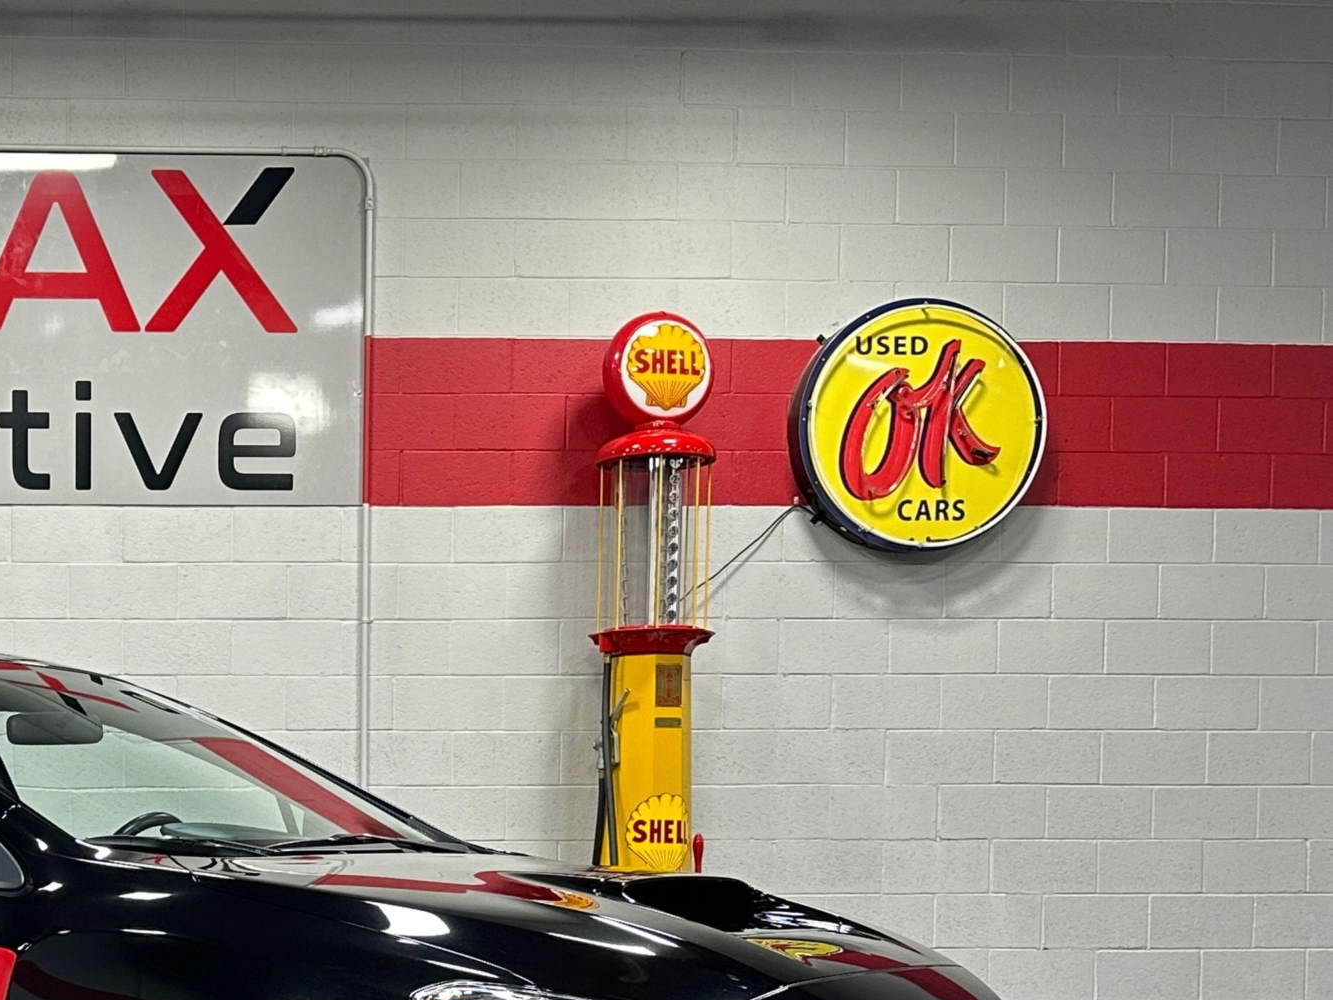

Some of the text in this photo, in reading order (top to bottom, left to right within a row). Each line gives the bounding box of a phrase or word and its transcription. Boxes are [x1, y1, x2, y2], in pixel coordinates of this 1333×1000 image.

[855, 335, 929, 356] USED
[634, 348, 701, 376] SHELL
[839, 338, 1002, 501] OK
[897, 498, 966, 521] CARS
